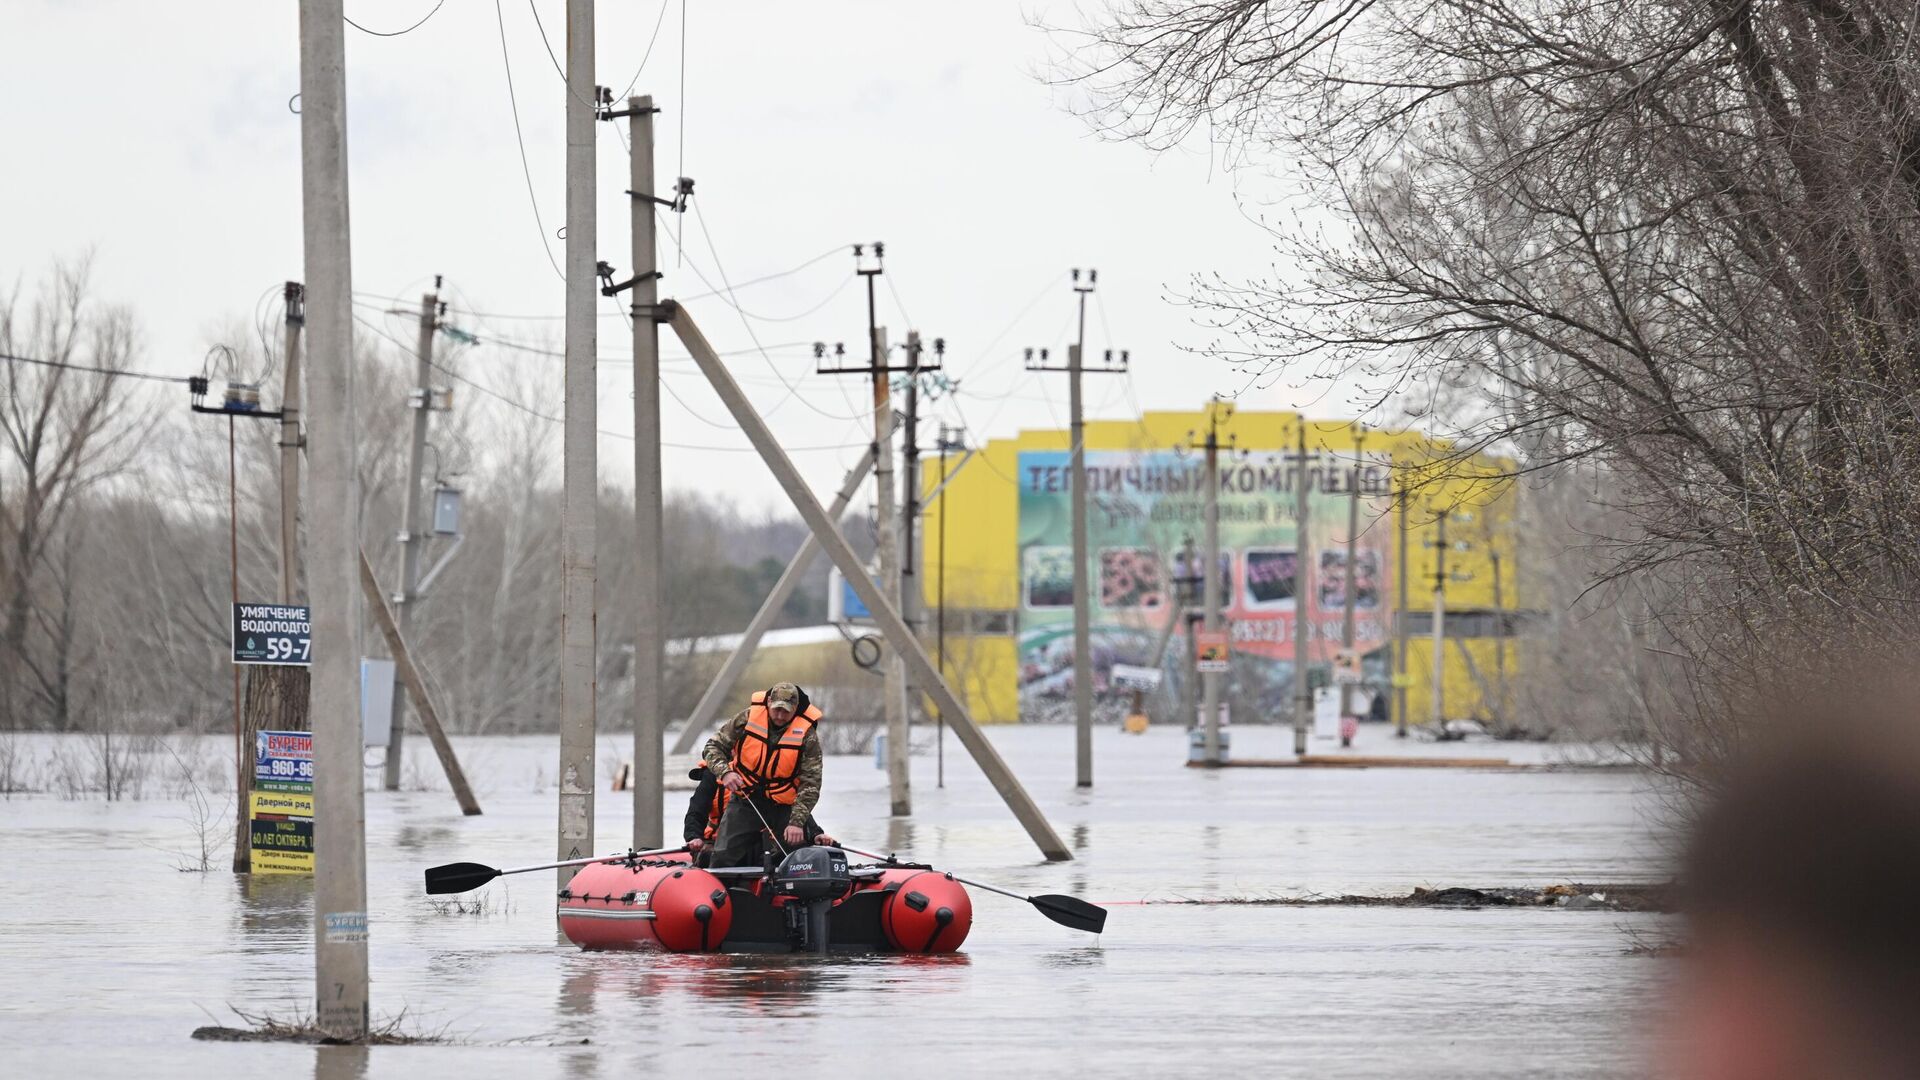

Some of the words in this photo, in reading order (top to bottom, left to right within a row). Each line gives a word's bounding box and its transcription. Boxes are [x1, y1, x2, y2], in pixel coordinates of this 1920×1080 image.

[240, 606, 306, 620] УМЯГЧЕНИЕ
[241, 620, 312, 634] ВОДОПОДГО
[267, 637, 312, 660] 59-7
[268, 735, 312, 751] БУРЕНИ
[272, 760, 313, 776] 960-96
[257, 797, 293, 807] Дверной
[253, 832, 262, 844] 60
[263, 833, 275, 845] ЛЕТ
[276, 834, 308, 848] ОКТЯБРЯ,
[789, 863, 813, 871] TARPON
[833, 863, 846, 872] 9.9
[334, 982, 345, 1001] 7
